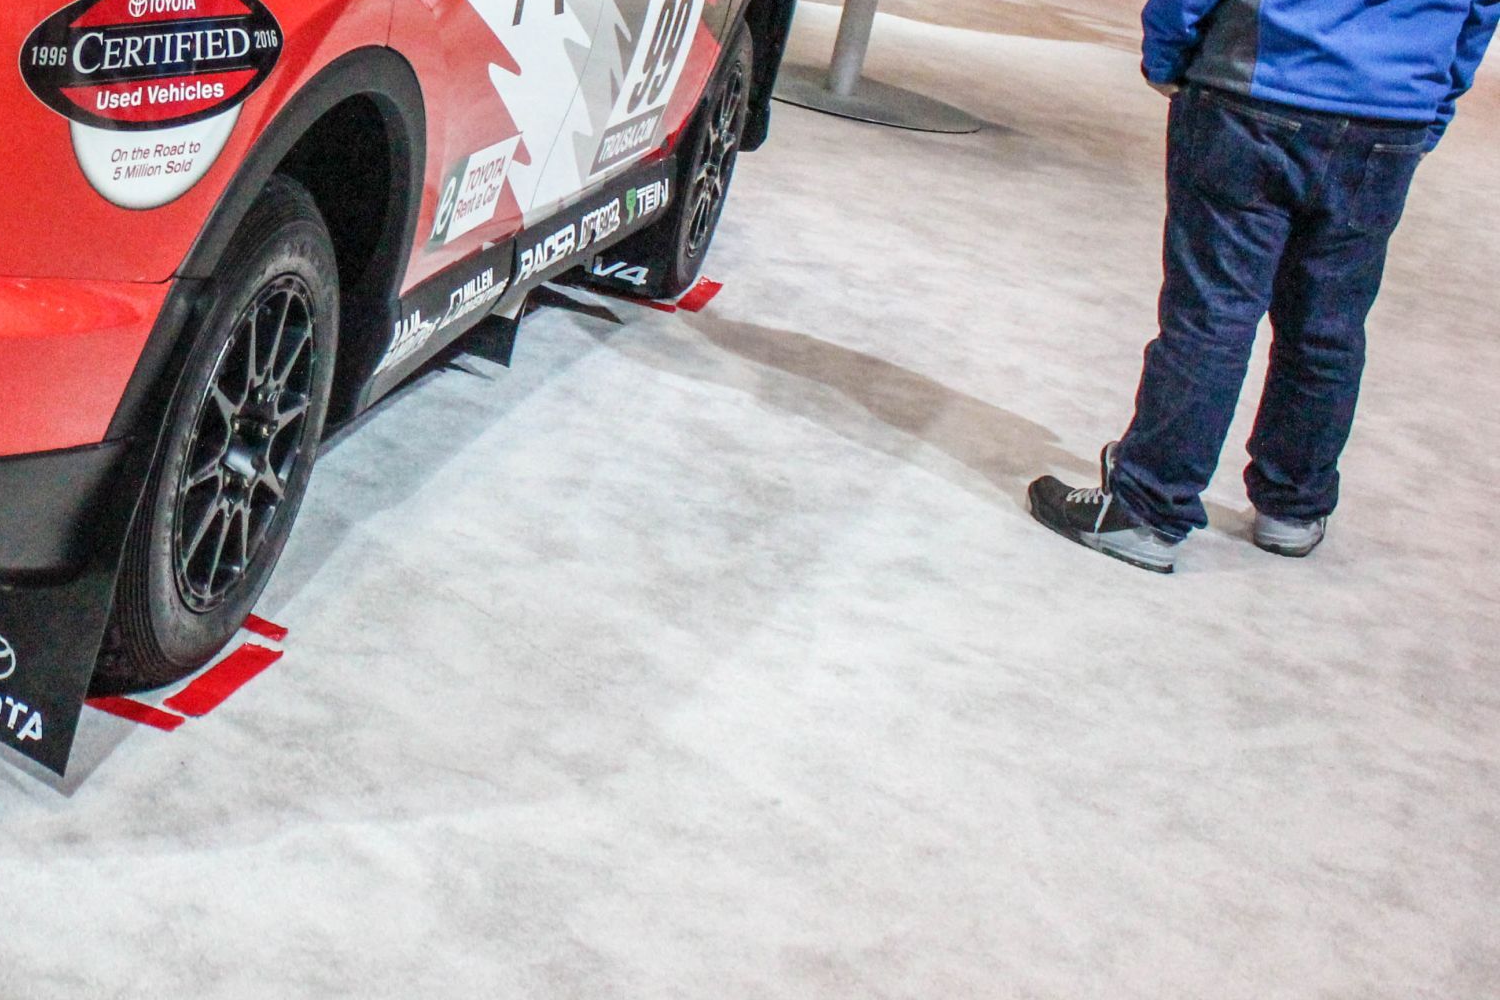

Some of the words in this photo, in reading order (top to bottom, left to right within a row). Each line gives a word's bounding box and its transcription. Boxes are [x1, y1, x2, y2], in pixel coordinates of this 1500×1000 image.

[31, 45, 68, 66] 1996
[71, 27, 251, 75] CERTIFIED
[253, 29, 279, 50] 2016
[95, 87, 143, 110] Used
[147, 81, 225, 105] Vehicles
[110, 147, 128, 163] On
[130, 144, 151, 161] the
[153, 141, 185, 159] Road
[188, 141, 201, 155] to
[112, 168, 122, 182] 5
[124, 163, 162, 179] Million
[164, 158, 194, 175] Sold
[465, 155, 506, 192] TOYOTA
[636, 178, 669, 218] TEIN
[513, 223, 576, 287] RACER
[593, 254, 650, 286] V4
